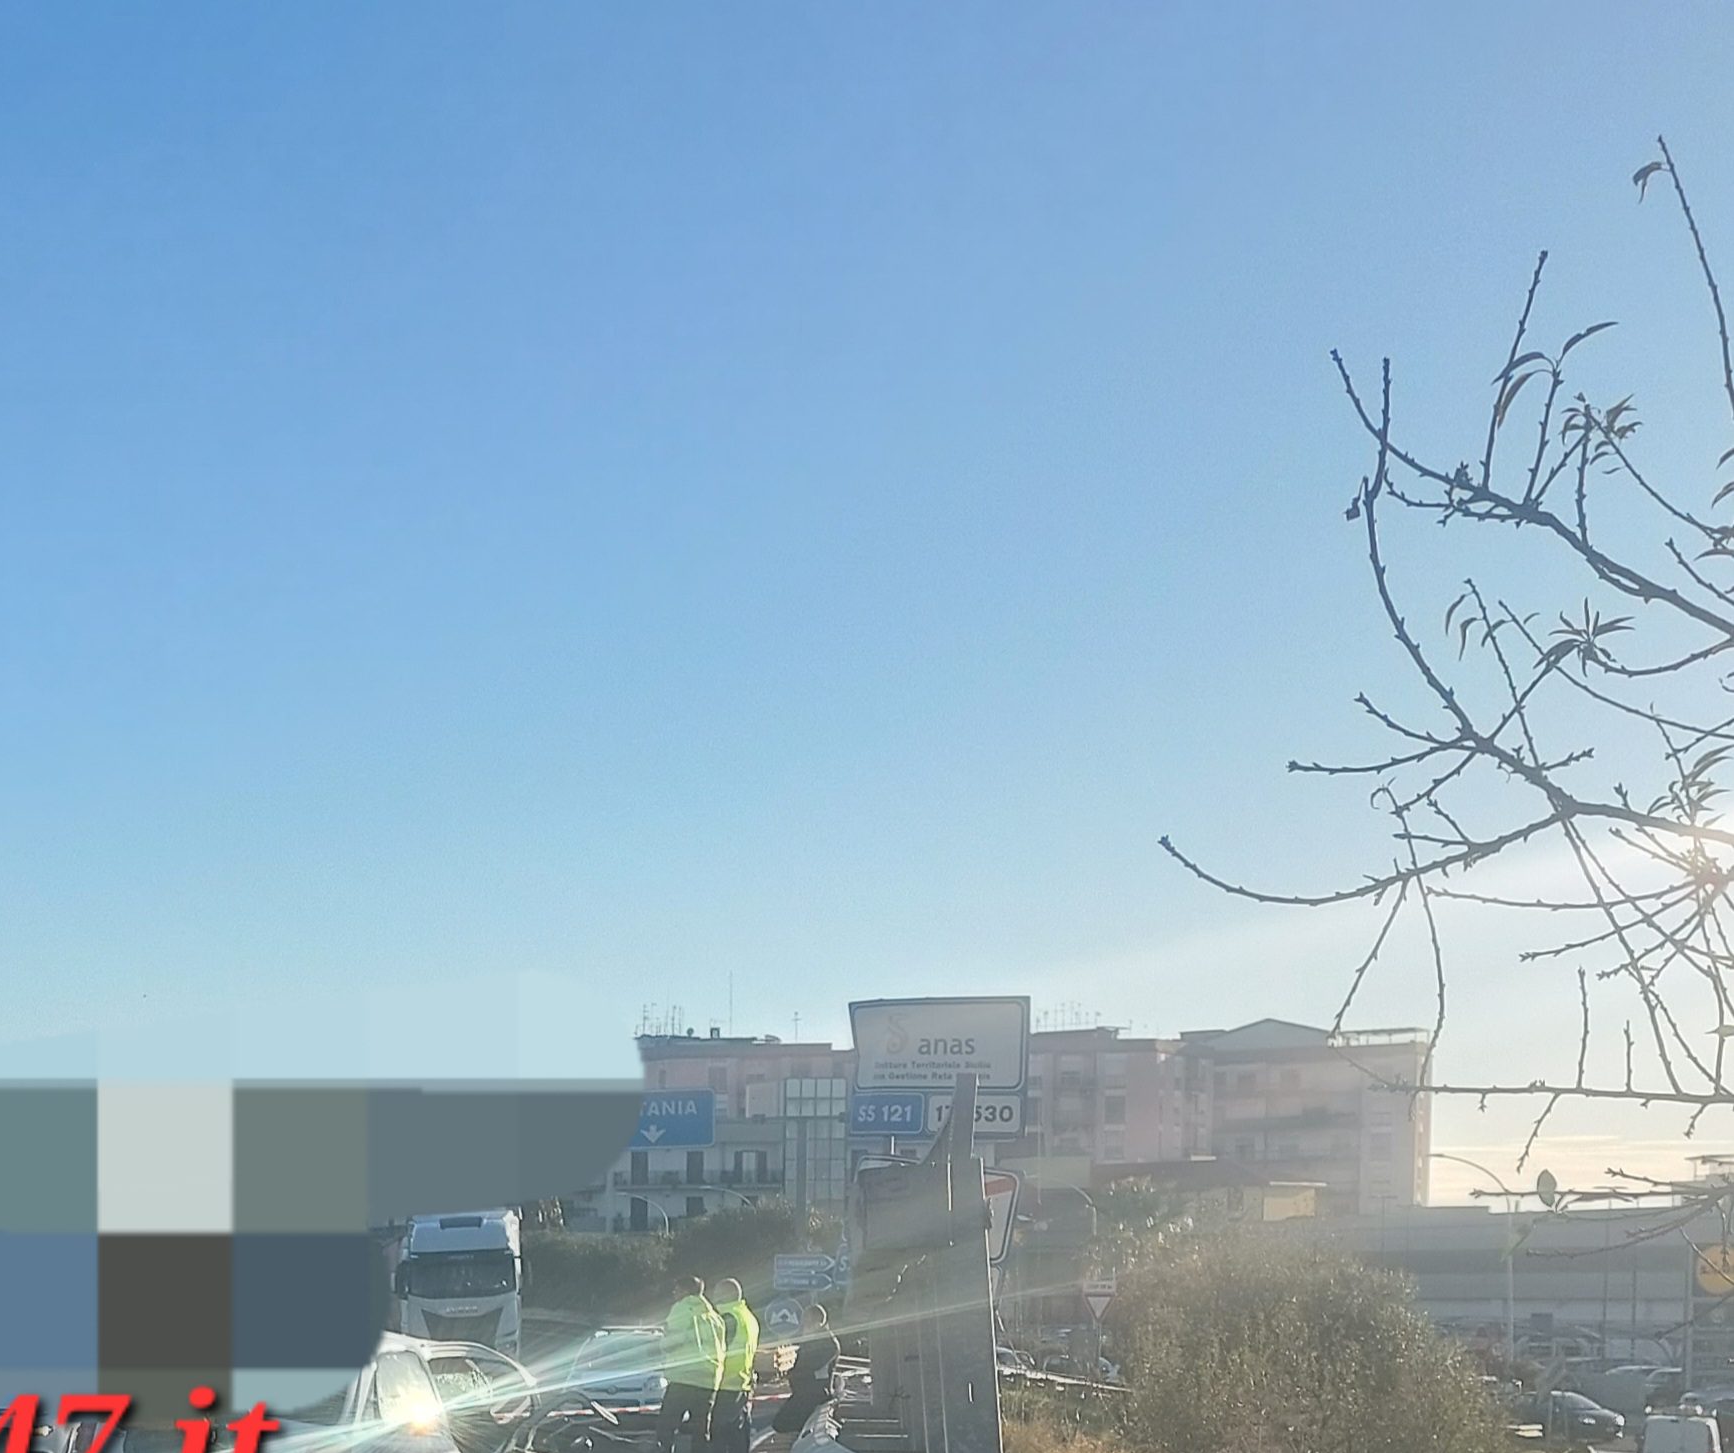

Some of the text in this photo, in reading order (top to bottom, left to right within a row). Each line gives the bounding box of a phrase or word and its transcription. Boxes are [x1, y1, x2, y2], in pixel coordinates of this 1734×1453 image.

[918, 1038, 976, 1055] anas
[858, 1104, 912, 1122] SS 121
